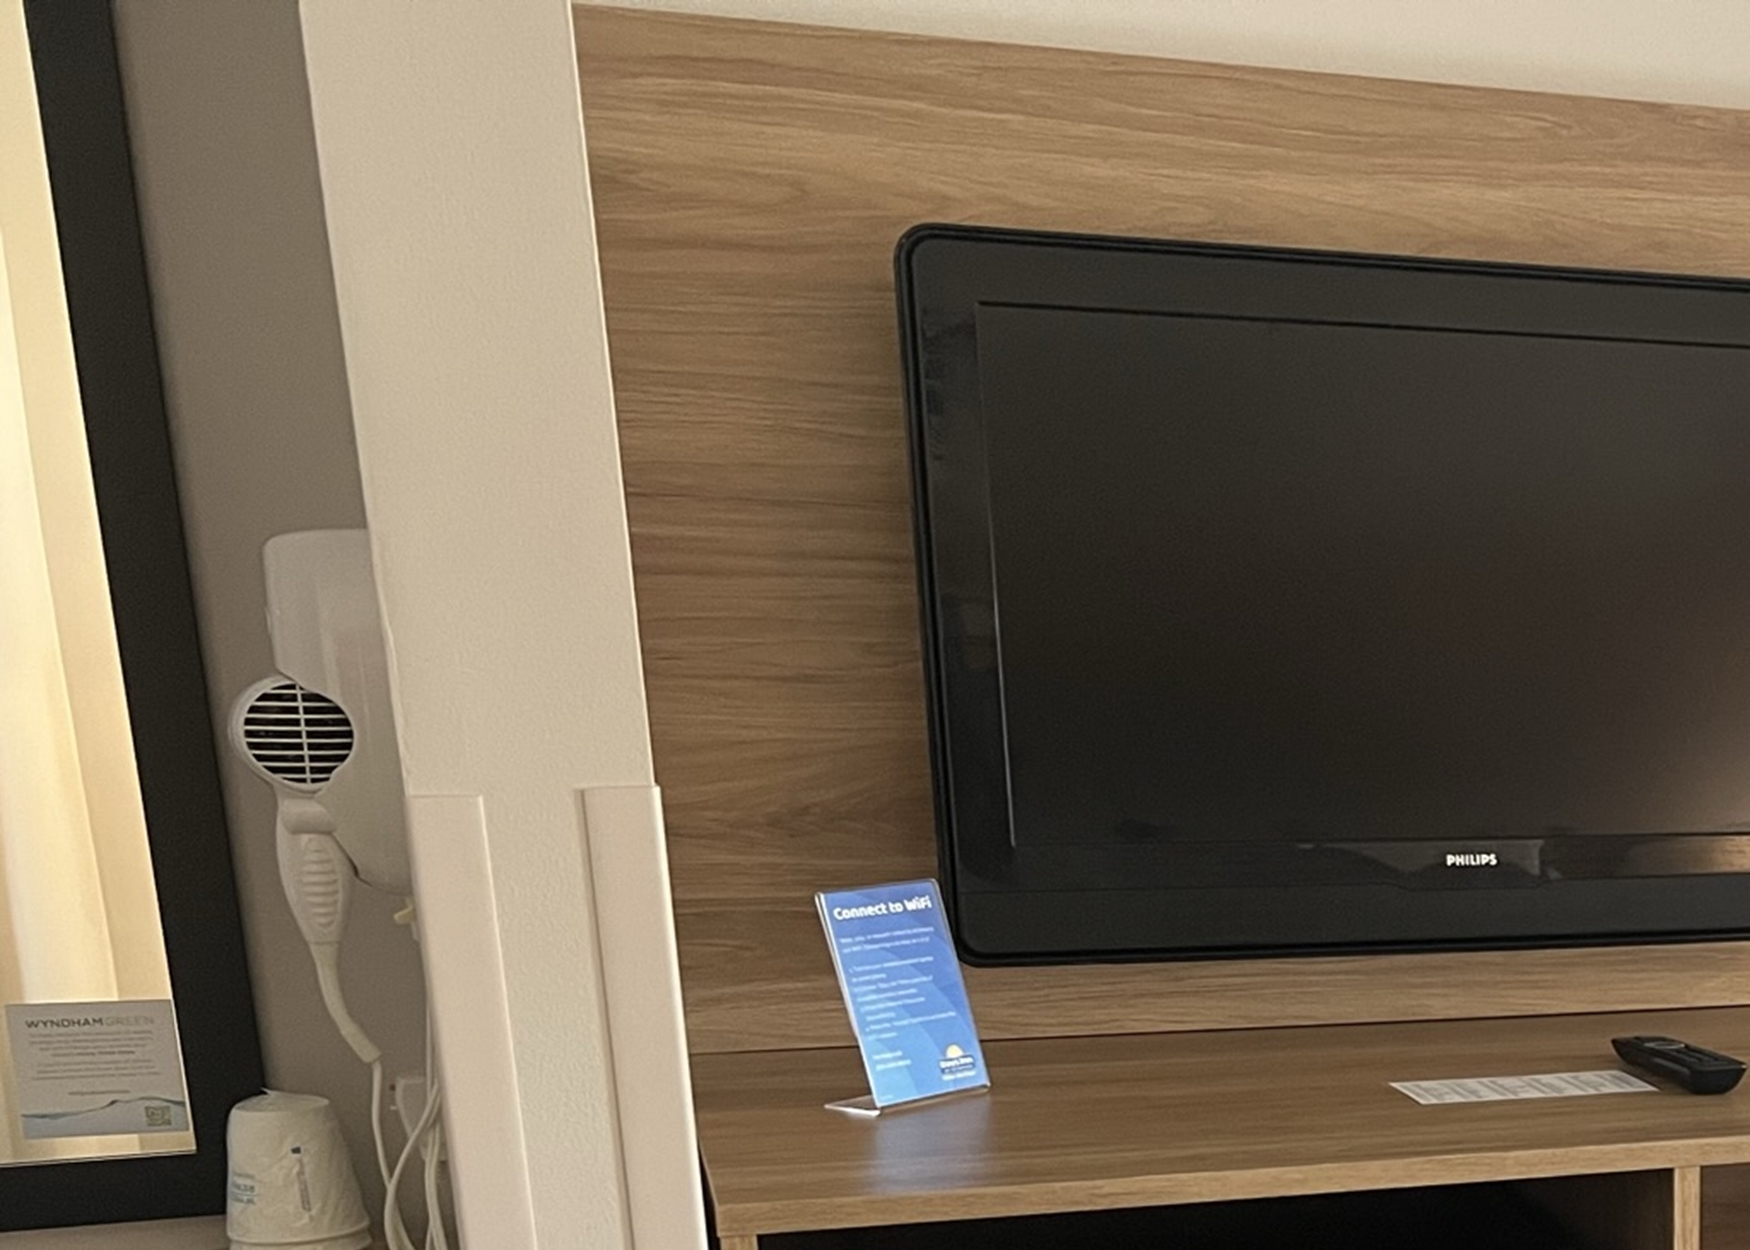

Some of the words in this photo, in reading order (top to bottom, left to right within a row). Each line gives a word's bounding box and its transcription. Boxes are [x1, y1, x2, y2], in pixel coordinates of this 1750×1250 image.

[1446, 853, 1498, 866] PHILIPS
[833, 902, 888, 920] Connect
[888, 901, 904, 913] to
[904, 895, 932, 911] WiFi
